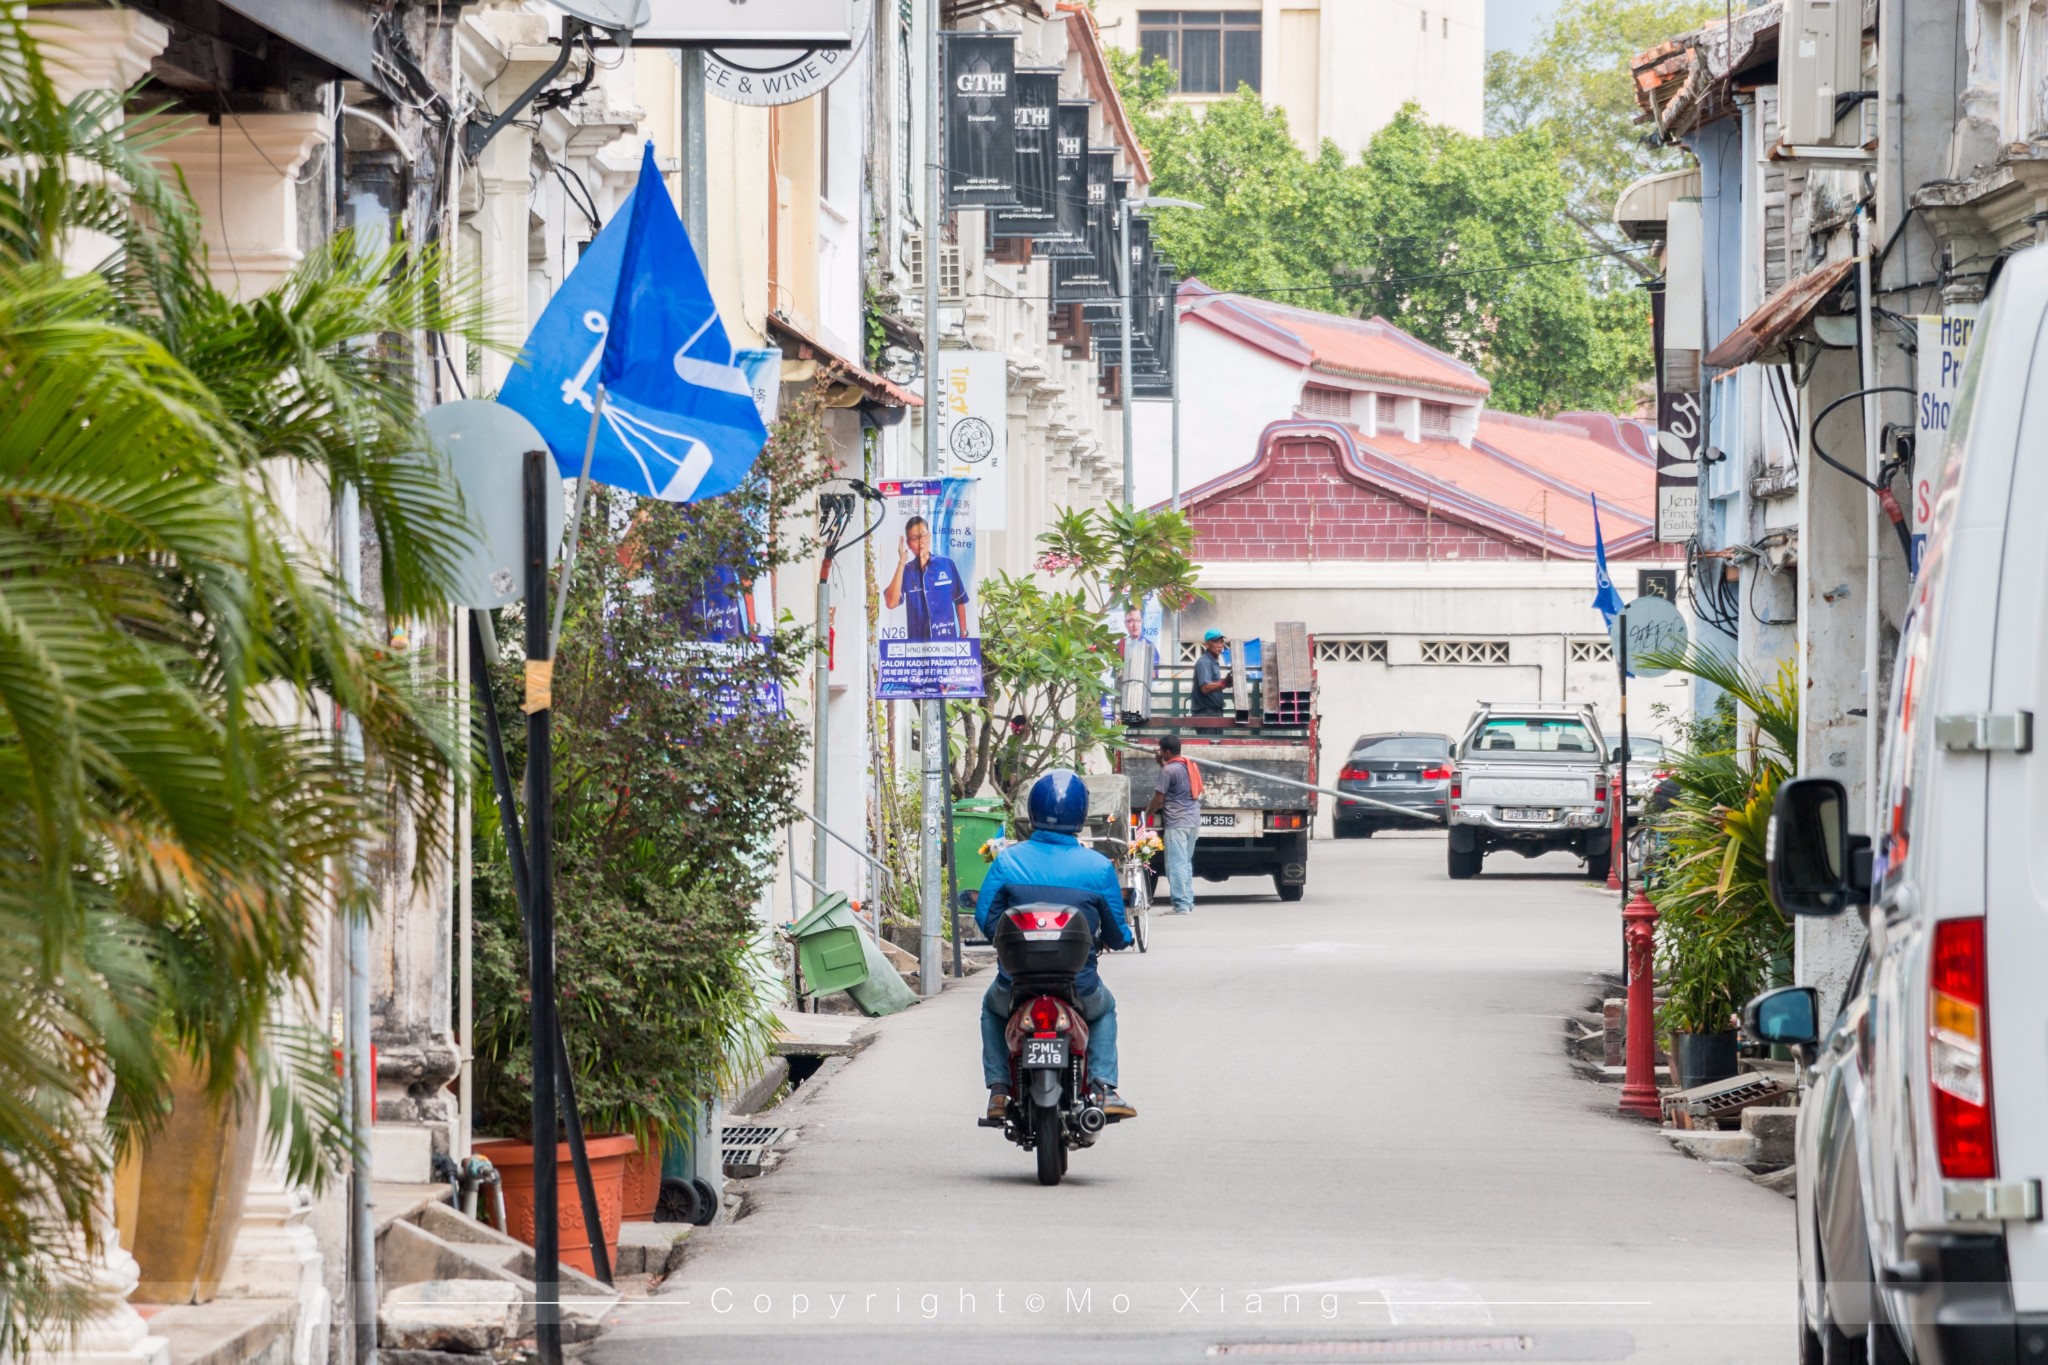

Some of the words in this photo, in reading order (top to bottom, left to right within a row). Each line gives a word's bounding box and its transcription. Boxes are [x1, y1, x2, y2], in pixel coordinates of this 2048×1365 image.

[738, 76, 752, 94] &
[762, 61, 820, 94] WINE
[820, 50, 842, 65] B
[967, 114, 996, 122] Evocative
[1662, 509, 1688, 518] Fine
[932, 526, 962, 536] Listen
[964, 526, 972, 536] &
[949, 538, 972, 549] Care
[882, 627, 906, 639] N26
[1143, 627, 1158, 636] N26
[941, 644, 955, 652] LENG
[880, 660, 905, 668] CALON
[906, 659, 930, 667] KADUN
[930, 659, 958, 667] PADANG
[959, 658, 978, 666] KOTA
[1477, 781, 1583, 799] TOYOTA
[1213, 815, 1234, 825] 3513
[1527, 811, 1548, 820] 5574
[1032, 1043, 1059, 1053] PML
[1027, 1053, 1062, 1064] 2418
